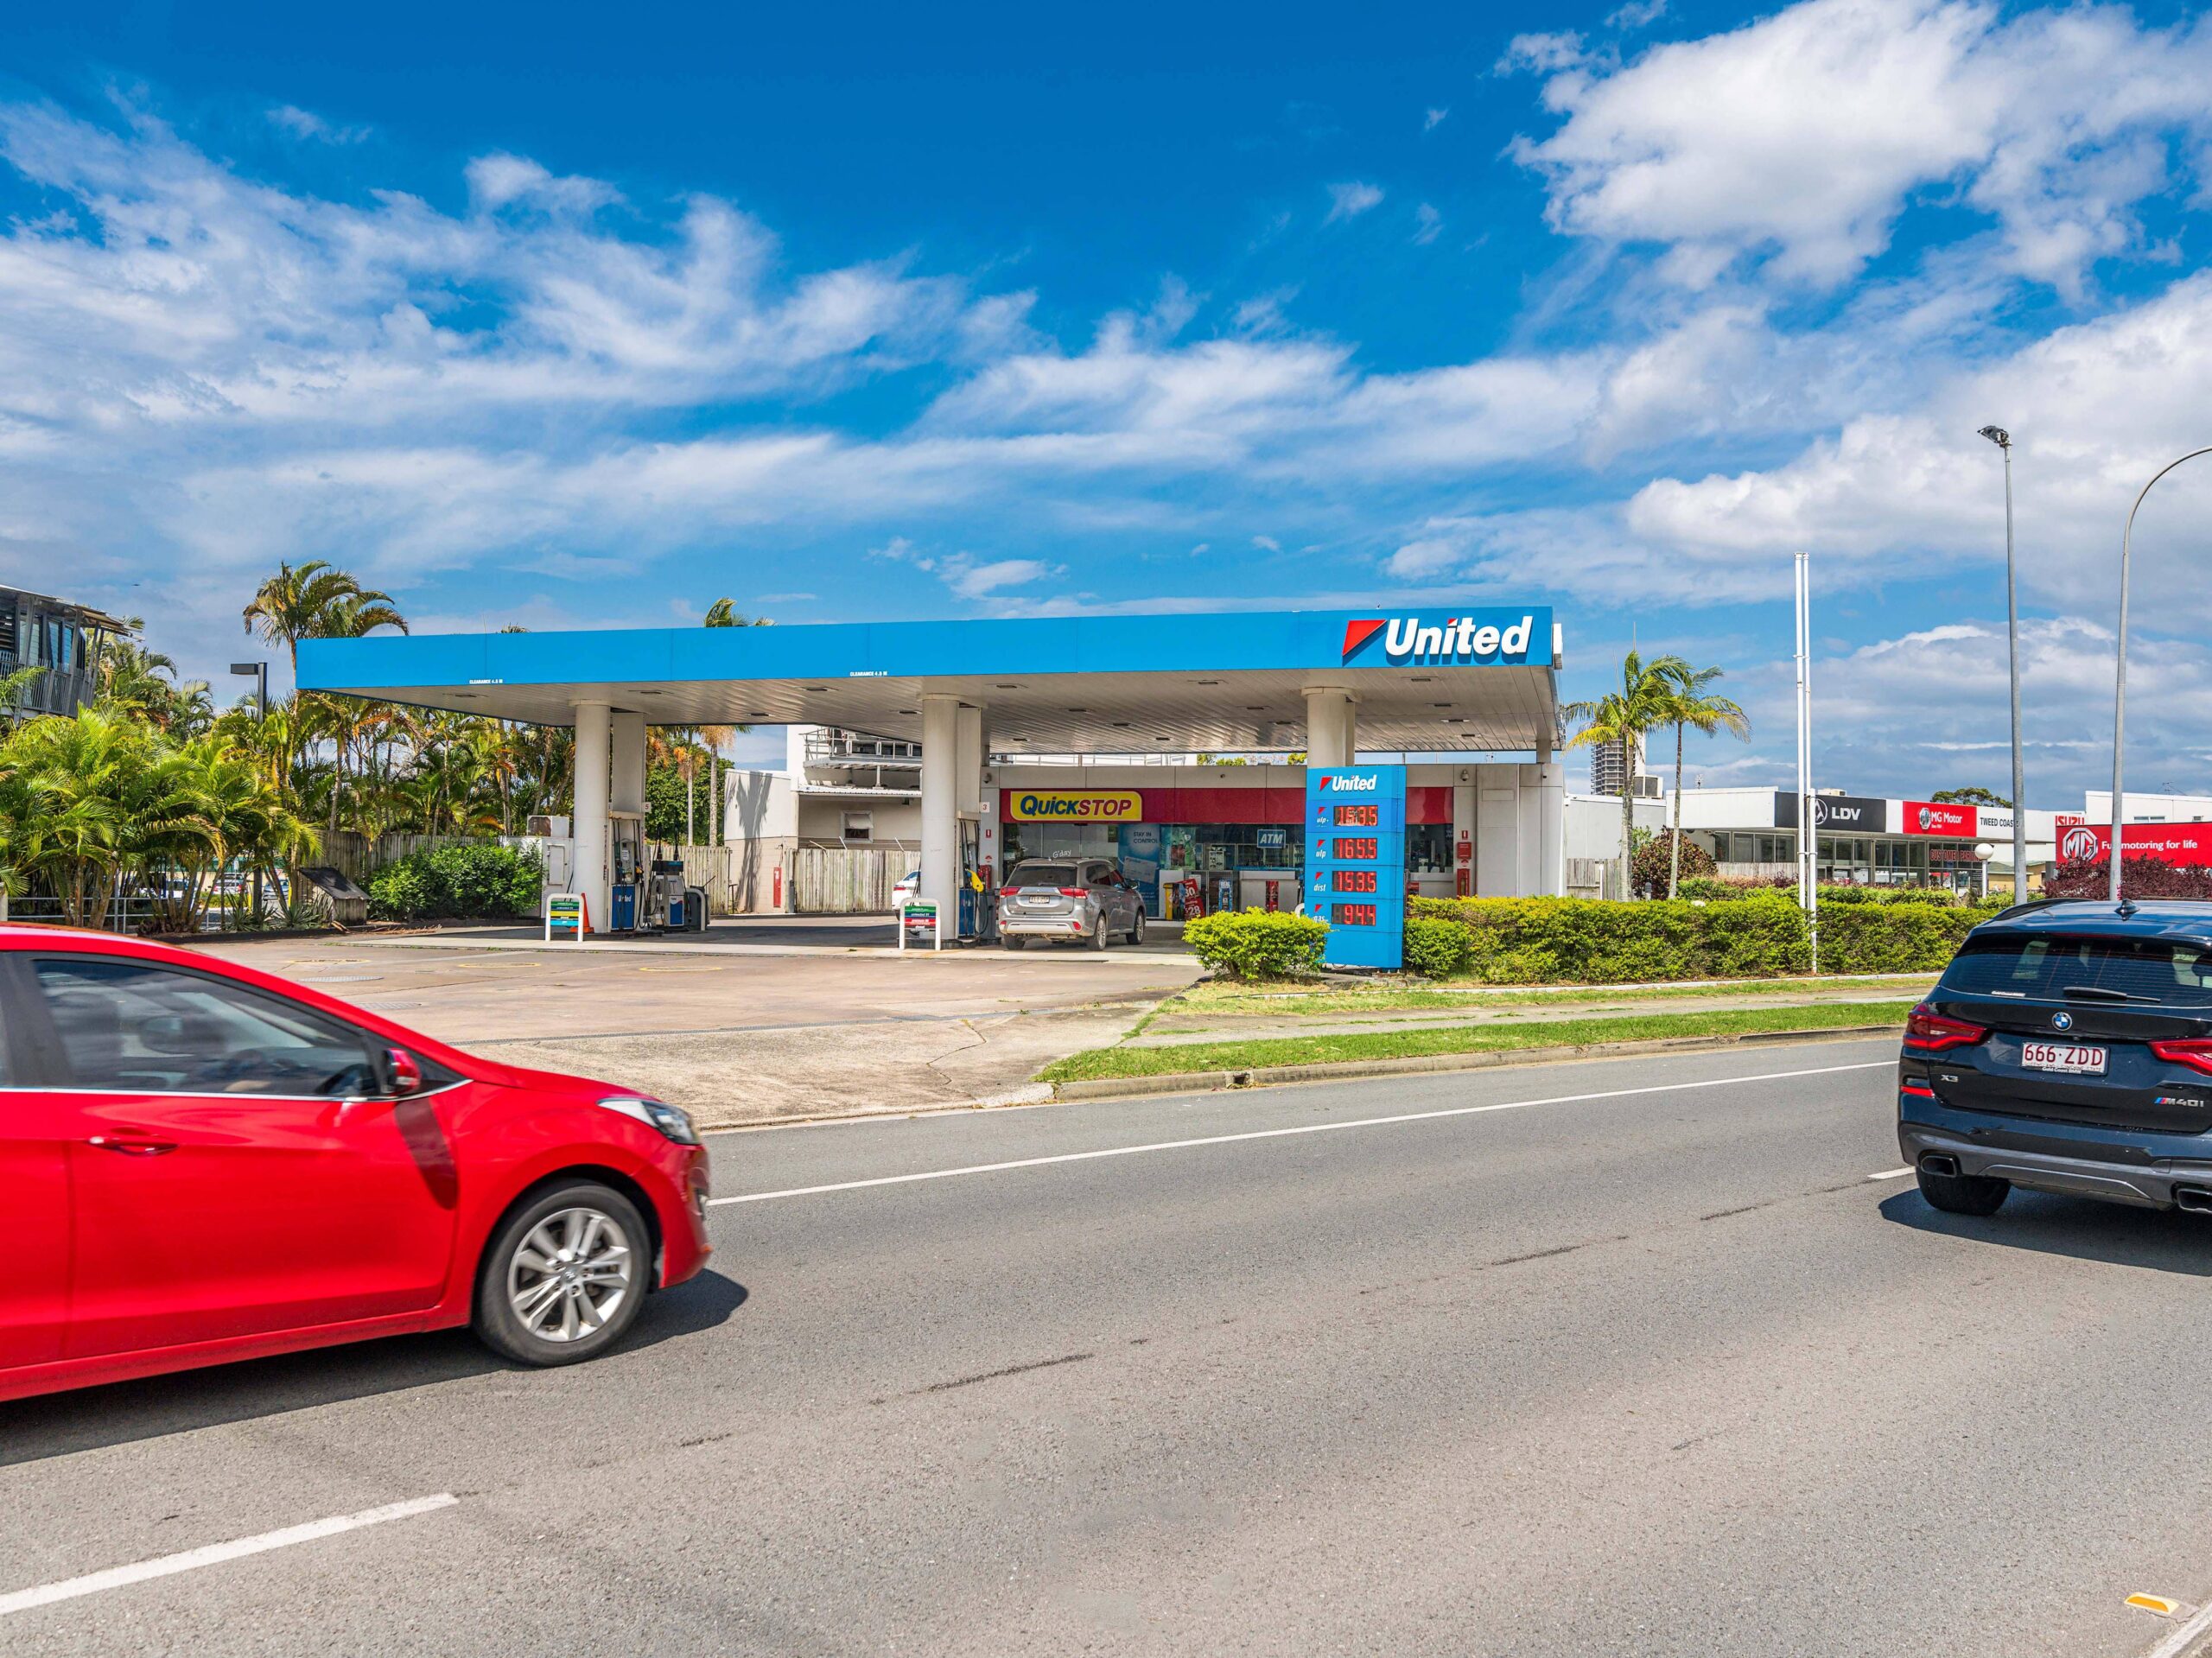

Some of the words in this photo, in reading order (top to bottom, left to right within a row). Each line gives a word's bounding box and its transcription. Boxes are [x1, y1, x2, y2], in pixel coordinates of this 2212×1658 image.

[1385, 616, 1533, 656] United
[1332, 774, 1376, 791] United
[1831, 807, 1860, 820] LDV
[1931, 811, 1942, 822] MG
[1944, 812, 1962, 823] Motor
[1980, 817, 1998, 827] TWEED
[1999, 818, 2014, 828] COAS
[1260, 834, 1283, 843] ATM
[1316, 850, 1326, 859] ulp
[1338, 839, 1376, 859] 165.5
[2101, 841, 2112, 849] Fu
[2121, 842, 2164, 851] motoring
[2166, 841, 2180, 849] for
[2183, 840, 2197, 848] life
[1053, 849, 1071, 859] G'day
[1941, 1074, 1959, 1083] X3
